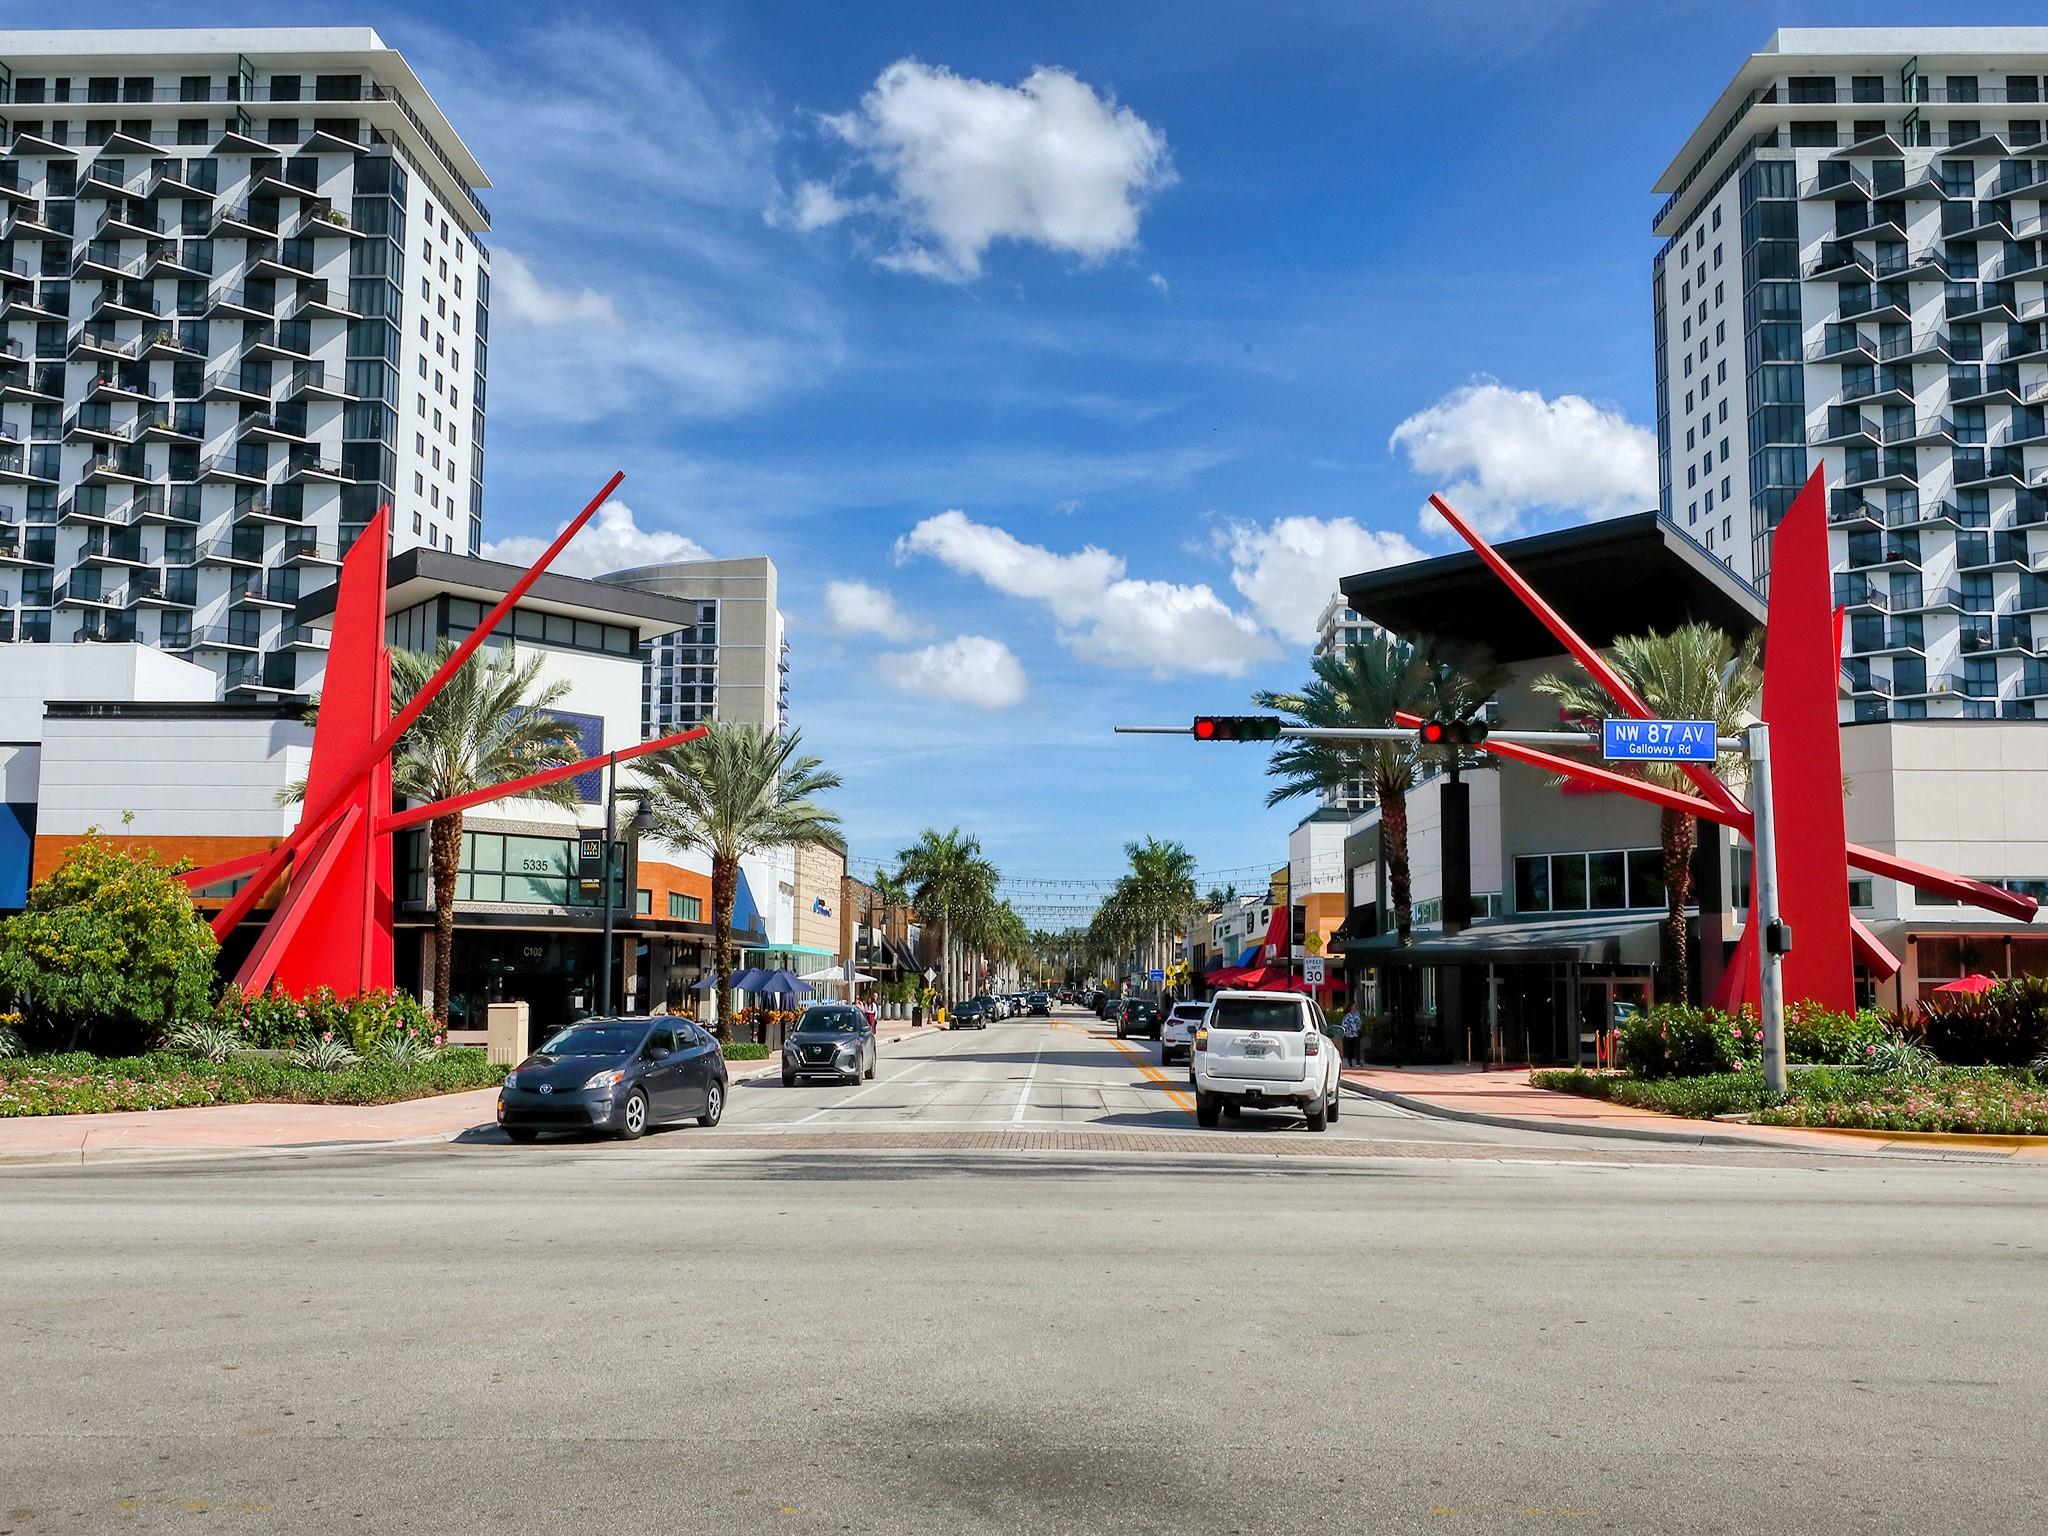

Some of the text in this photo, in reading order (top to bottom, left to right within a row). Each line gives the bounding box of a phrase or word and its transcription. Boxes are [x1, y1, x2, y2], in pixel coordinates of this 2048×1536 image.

[1615, 724, 1704, 744] NW 87 AV
[1629, 743, 1691, 756] Galloway Rd
[583, 842, 598, 851] LUX
[523, 859, 548, 871] 5335
[523, 946, 543, 957] C102
[1306, 971, 1323, 982] 30
